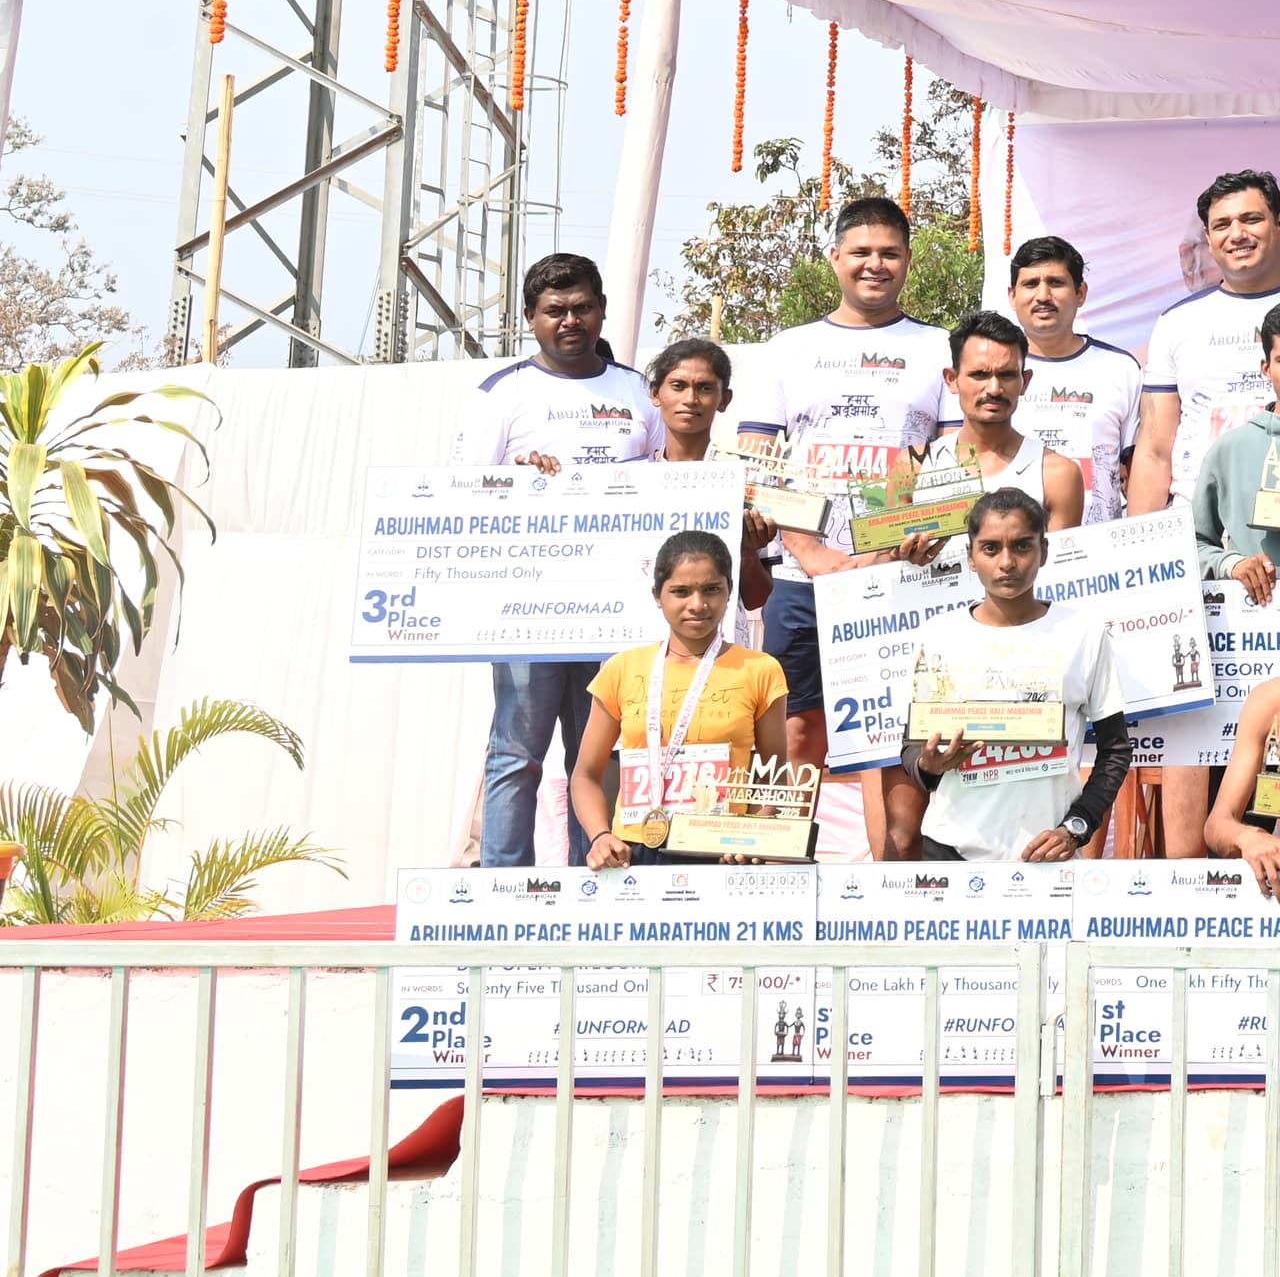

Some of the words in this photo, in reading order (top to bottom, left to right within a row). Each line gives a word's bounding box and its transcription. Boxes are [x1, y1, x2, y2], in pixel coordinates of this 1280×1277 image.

[842, 394, 875, 406] हमर
[374, 516, 464, 535] ABUJHMAD
[469, 516, 521, 534] PEACE
[527, 515, 568, 533] HALF
[574, 513, 664, 533] MARATHON
[670, 512, 688, 530] 21
[694, 511, 730, 531] KMS
[416, 546, 451, 558] DIST
[457, 545, 502, 558] OPEN
[508, 543, 595, 558] CATEGORY
[415, 568, 442, 583] Fifty
[446, 567, 507, 579] Thousand
[512, 566, 542, 581] Only
[1125, 568, 1144, 589] 21
[1149, 560, 1186, 584] KMS
[501, 601, 624, 616] #RUNFORMAAD
[388, 610, 441, 628] Place
[831, 610, 920, 644] ABUJHMAD
[388, 629, 440, 641] Winner
[880, 668, 907, 681] One
[983, 770, 999, 780] NPR
[630, 922, 730, 941] MARATHON
[737, 921, 756, 941] 21
[763, 921, 803, 941] KMS
[816, 921, 898, 940] BUJHMAD
[904, 921, 959, 940] PEACE
[966, 920, 1011, 939] HALF
[1087, 917, 1188, 937] ABUJHMAD
[1195, 917, 1253, 937] PEACE
[516, 981, 545, 994] Five
[849, 979, 878, 992] One
[884, 978, 914, 992] Lakh
[1136, 975, 1167, 988] One
[1212, 974, 1241, 992] Fifty
[1101, 1023, 1161, 1043] Place
[1101, 1045, 1160, 1058] Winner
